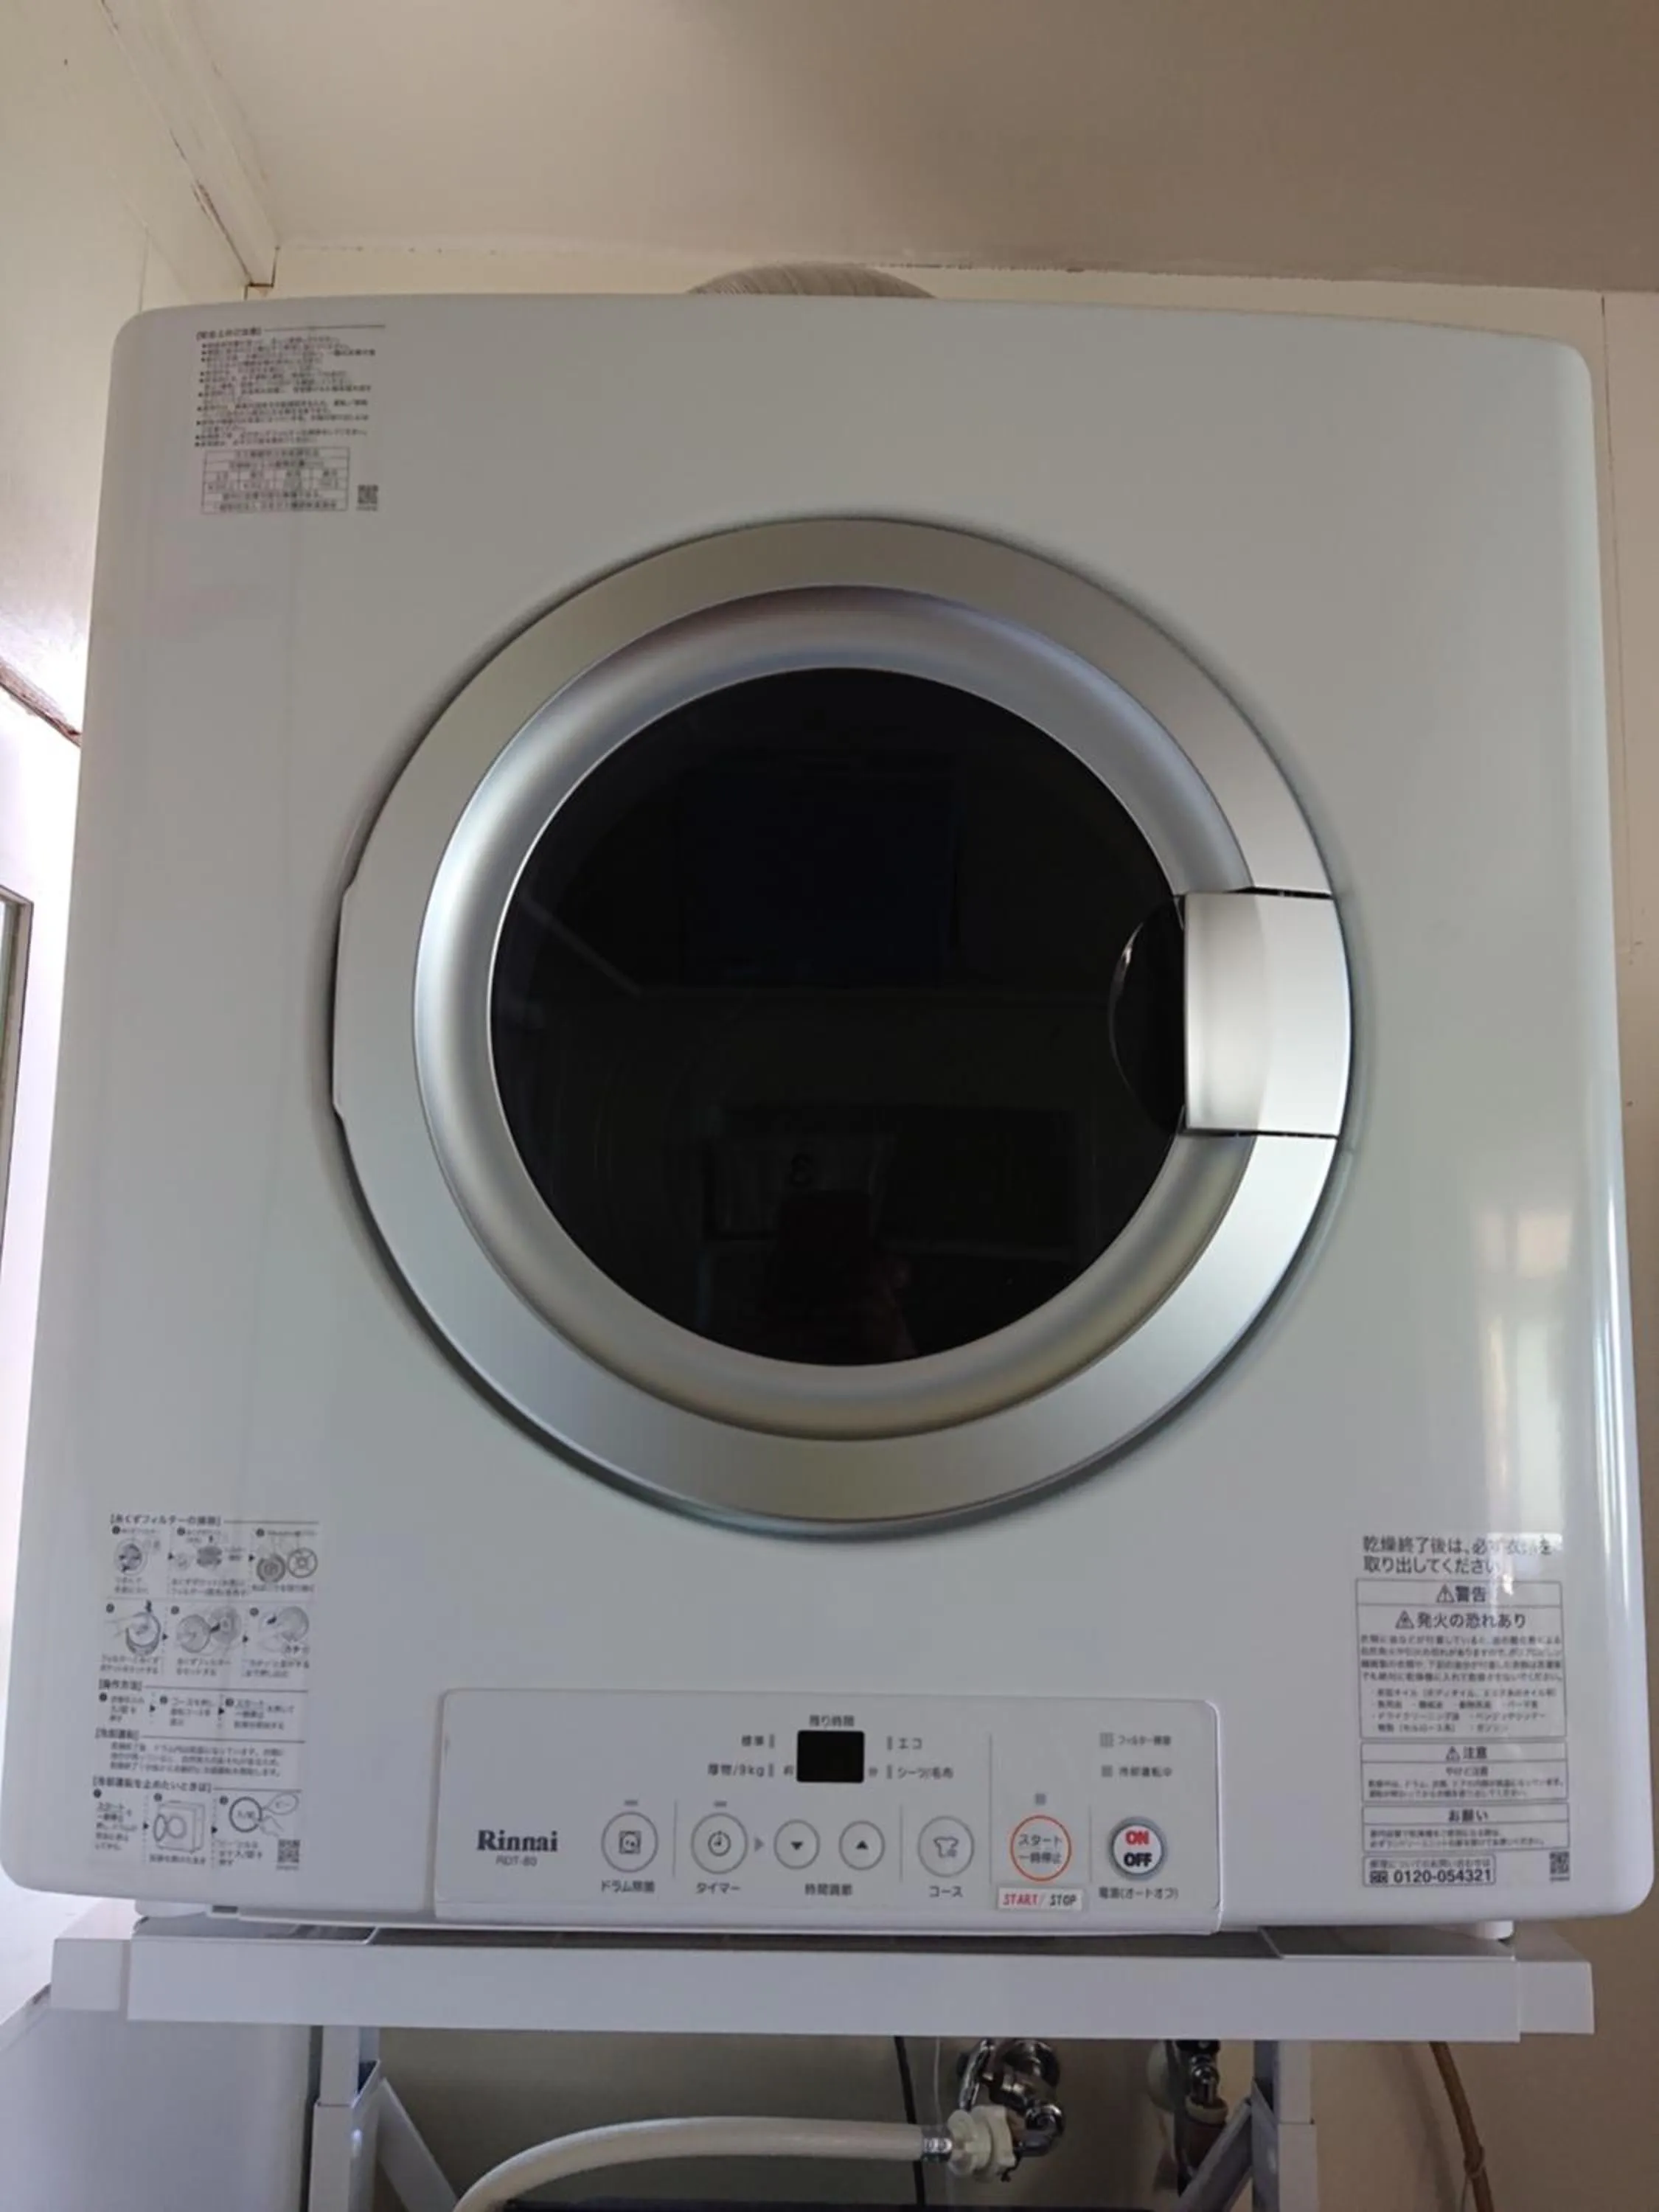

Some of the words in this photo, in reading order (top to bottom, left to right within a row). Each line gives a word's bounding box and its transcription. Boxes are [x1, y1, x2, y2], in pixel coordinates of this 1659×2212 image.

[1455, 1585, 1488, 1603] 警告
[1416, 1611, 1526, 1629] 発火の恐れあり
[897, 1736, 922, 1750] エコ
[476, 1829, 558, 1853] Rinnai
[1018, 1834, 1062, 1847] スタート
[1125, 1830, 1150, 1846] ON
[1123, 1852, 1152, 1868] OFF
[1393, 1869, 1492, 1883] 0120-054321
[695, 1882, 741, 1895] タイマー
[929, 1885, 964, 1899] コース
[1003, 1893, 1039, 1906] START
[1049, 1893, 1077, 1906] STOP
